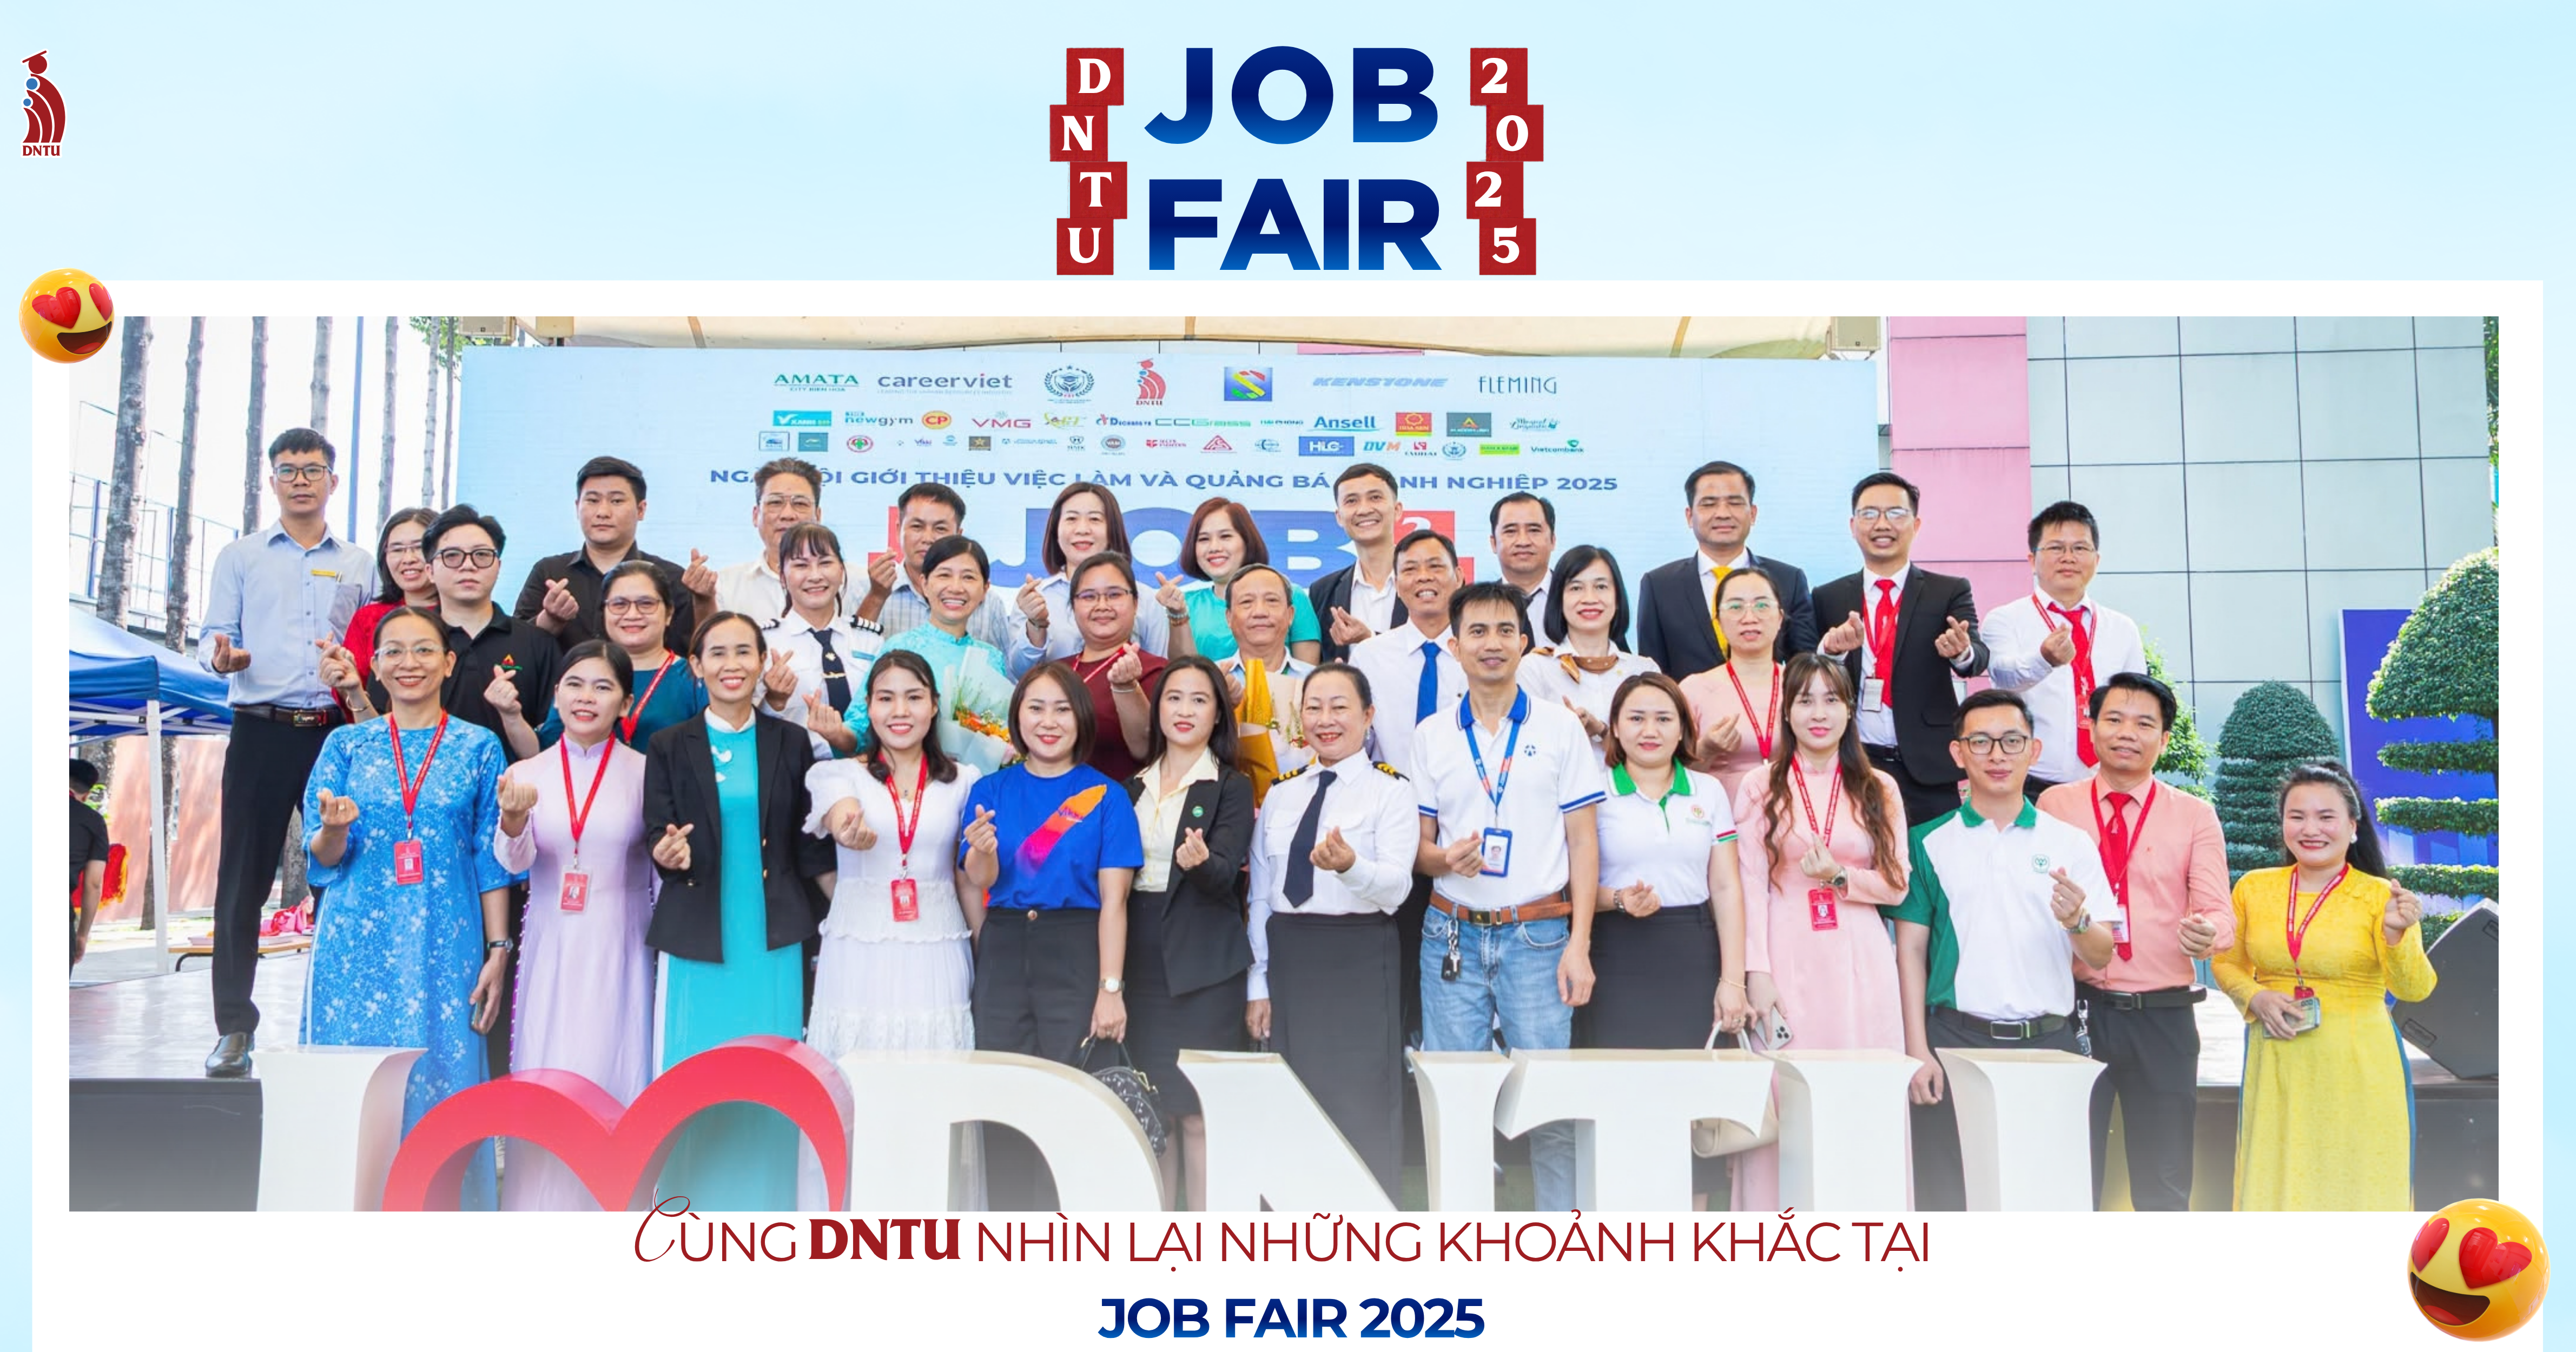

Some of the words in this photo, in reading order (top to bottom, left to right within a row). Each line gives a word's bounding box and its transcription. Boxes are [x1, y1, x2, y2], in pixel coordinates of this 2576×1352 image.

[774, 374, 859, 384] AMATA
[877, 373, 1013, 388] careerviet
[1313, 377, 1449, 387] KENSTONE
[1478, 376, 1557, 394] FLEMING
[924, 415, 948, 425] CP
[972, 418, 1032, 428] VMG
[1313, 416, 1376, 428] Ansell
[851, 468, 907, 485] GIỚI
[915, 469, 995, 488] THIỆU
[1003, 469, 1066, 489] VIỆC
[1140, 470, 1178, 487] VÀ
[1185, 470, 1283, 489] QUẢNG
[1292, 472, 1330, 488] BÁ
[1447, 474, 1549, 493] NGHIỆP
[1556, 478, 1618, 490] 2025
